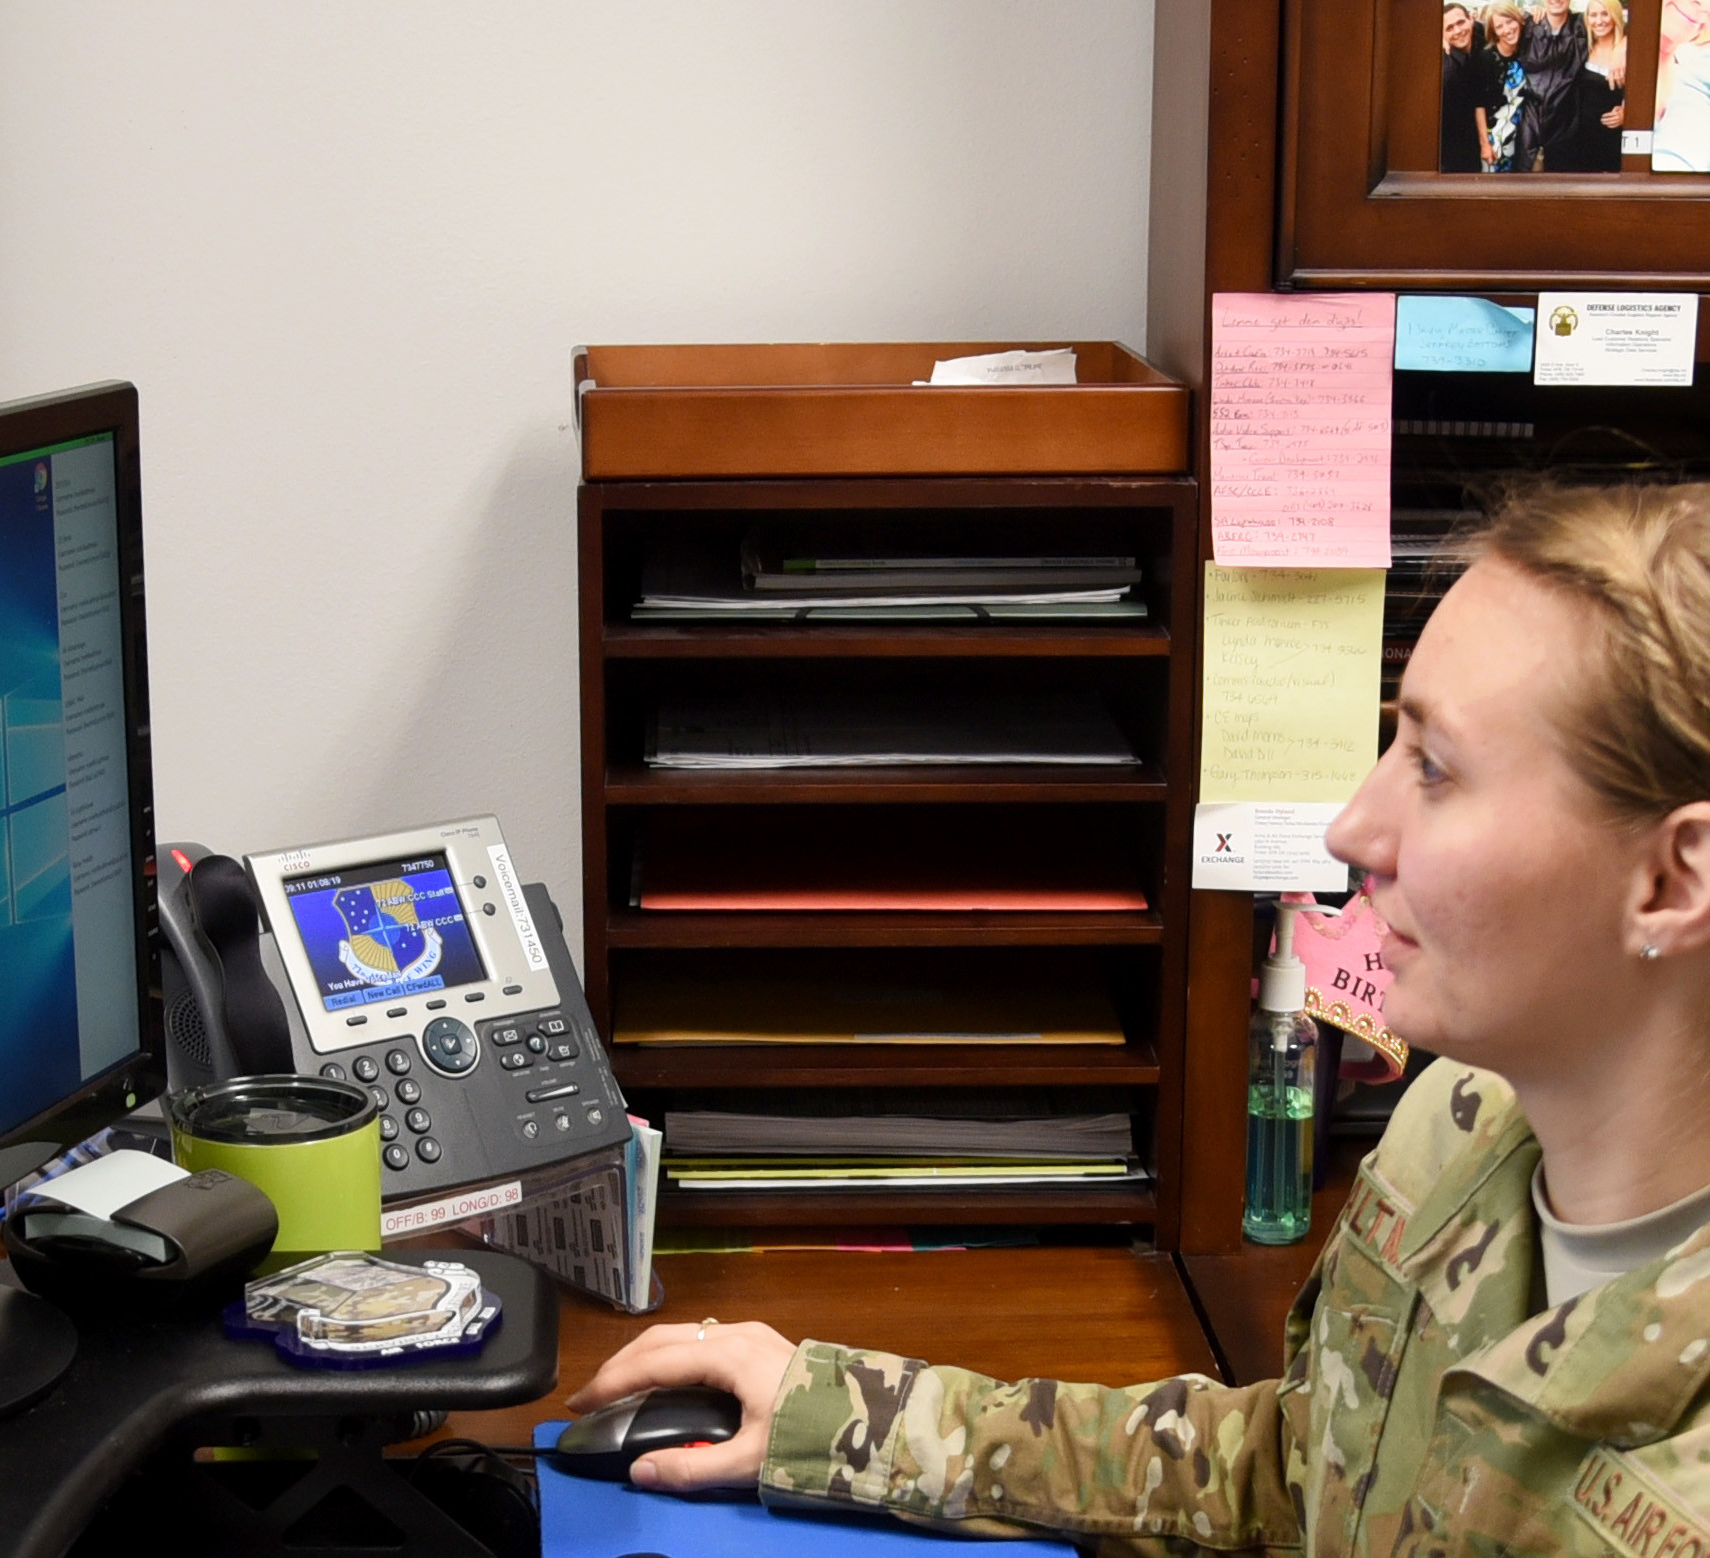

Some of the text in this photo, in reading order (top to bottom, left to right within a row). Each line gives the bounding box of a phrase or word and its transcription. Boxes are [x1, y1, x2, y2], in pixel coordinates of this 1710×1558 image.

[283, 861, 310, 872] CISCO
[402, 860, 434, 871] 7347750
[388, 894, 408, 906] ABW
[409, 892, 426, 902] CCC
[427, 888, 445, 898] Staff
[495, 854, 542, 964] Voicemail:731450
[416, 919, 435, 930] ABW
[436, 916, 454, 927] CCC
[414, 951, 437, 975] WING
[327, 981, 342, 992] You
[332, 996, 356, 1007] Redial
[368, 991, 384, 1001] New
[386, 988, 401, 999] Call
[386, 1188, 519, 1231] OFF/B: 99 LONG/D: 98
[1574, 1457, 1611, 1519] U.S.
